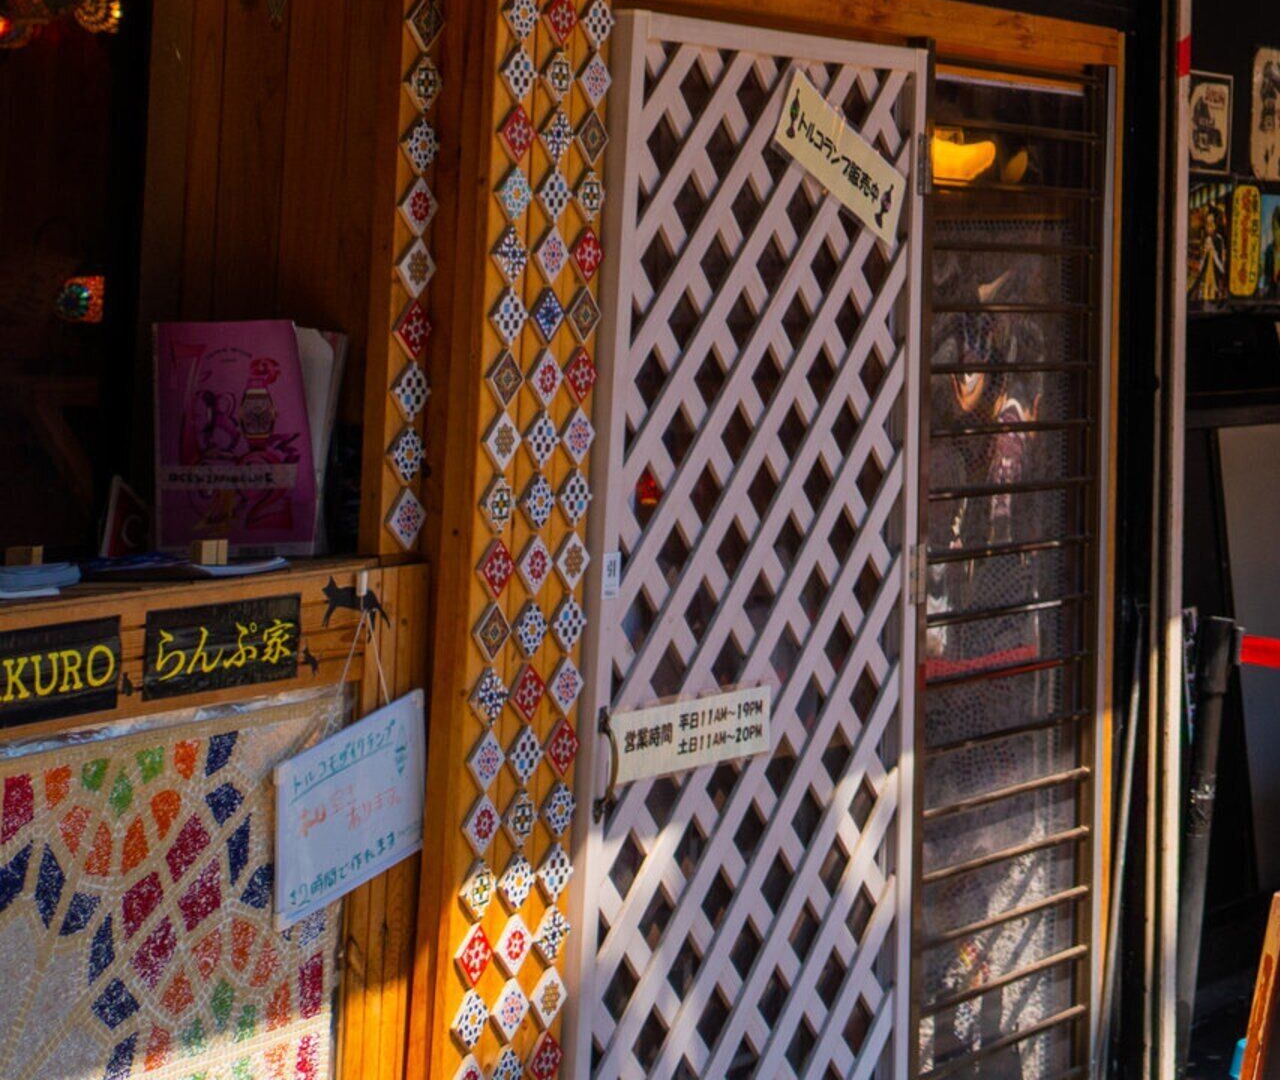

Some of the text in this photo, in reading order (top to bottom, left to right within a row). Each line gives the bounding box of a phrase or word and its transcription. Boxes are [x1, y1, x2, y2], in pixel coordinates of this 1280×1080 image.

[797, 111, 880, 203] トルコランプ販売中
[0, 644, 116, 703] KURO
[155, 618, 295, 682] らんぷ家
[624, 722, 673, 754] 営業時間
